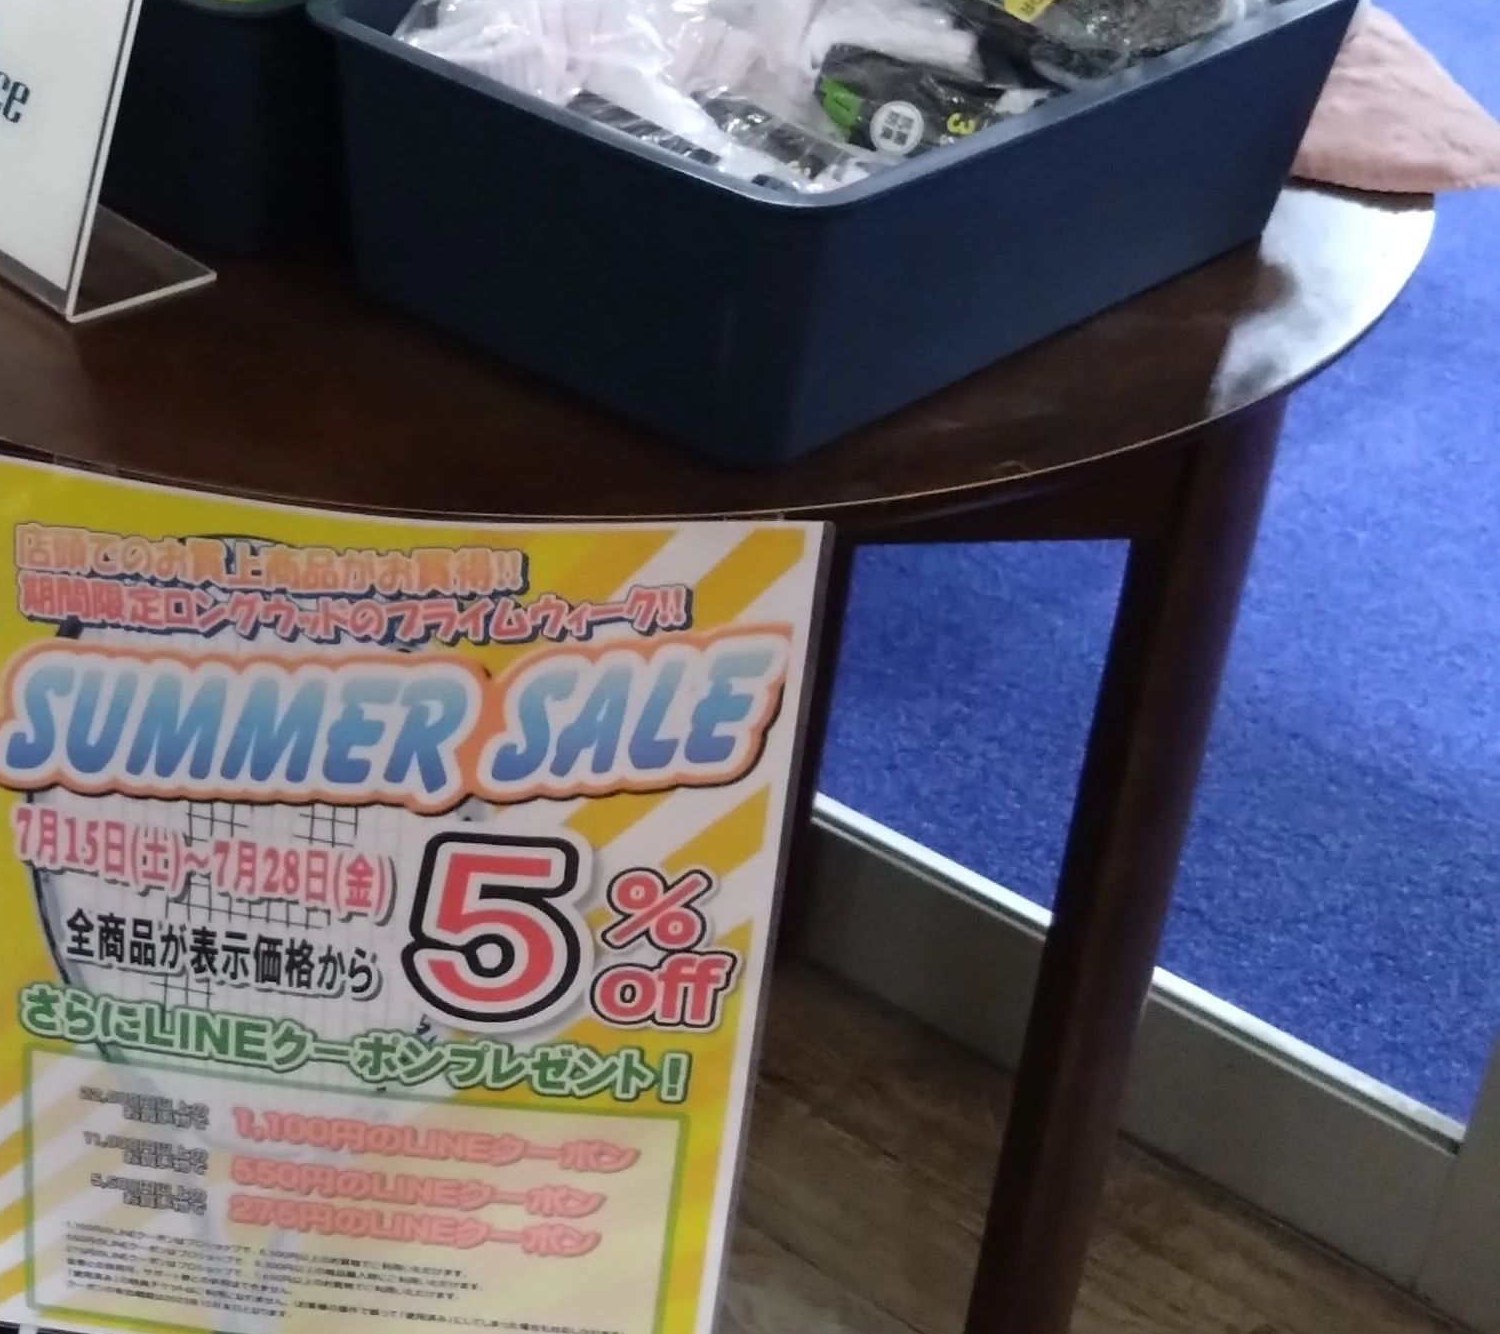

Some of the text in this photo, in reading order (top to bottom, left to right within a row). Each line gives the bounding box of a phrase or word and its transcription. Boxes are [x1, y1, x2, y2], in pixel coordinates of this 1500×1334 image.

[0, 635, 784, 801] SUMMER SALE
[65, 907, 379, 995] 全商品が表示価格から
[402, 832, 581, 1022] 5
[590, 951, 737, 1028] off
[19, 985, 691, 1102] さらにLINEクーポンプレゼント！
[232, 1106, 641, 1174] 1,100円のLINEクーポン
[228, 1193, 603, 1258] 275円のLINEクーポン
[230, 1155, 607, 1219] 550円のLINEクーポン
